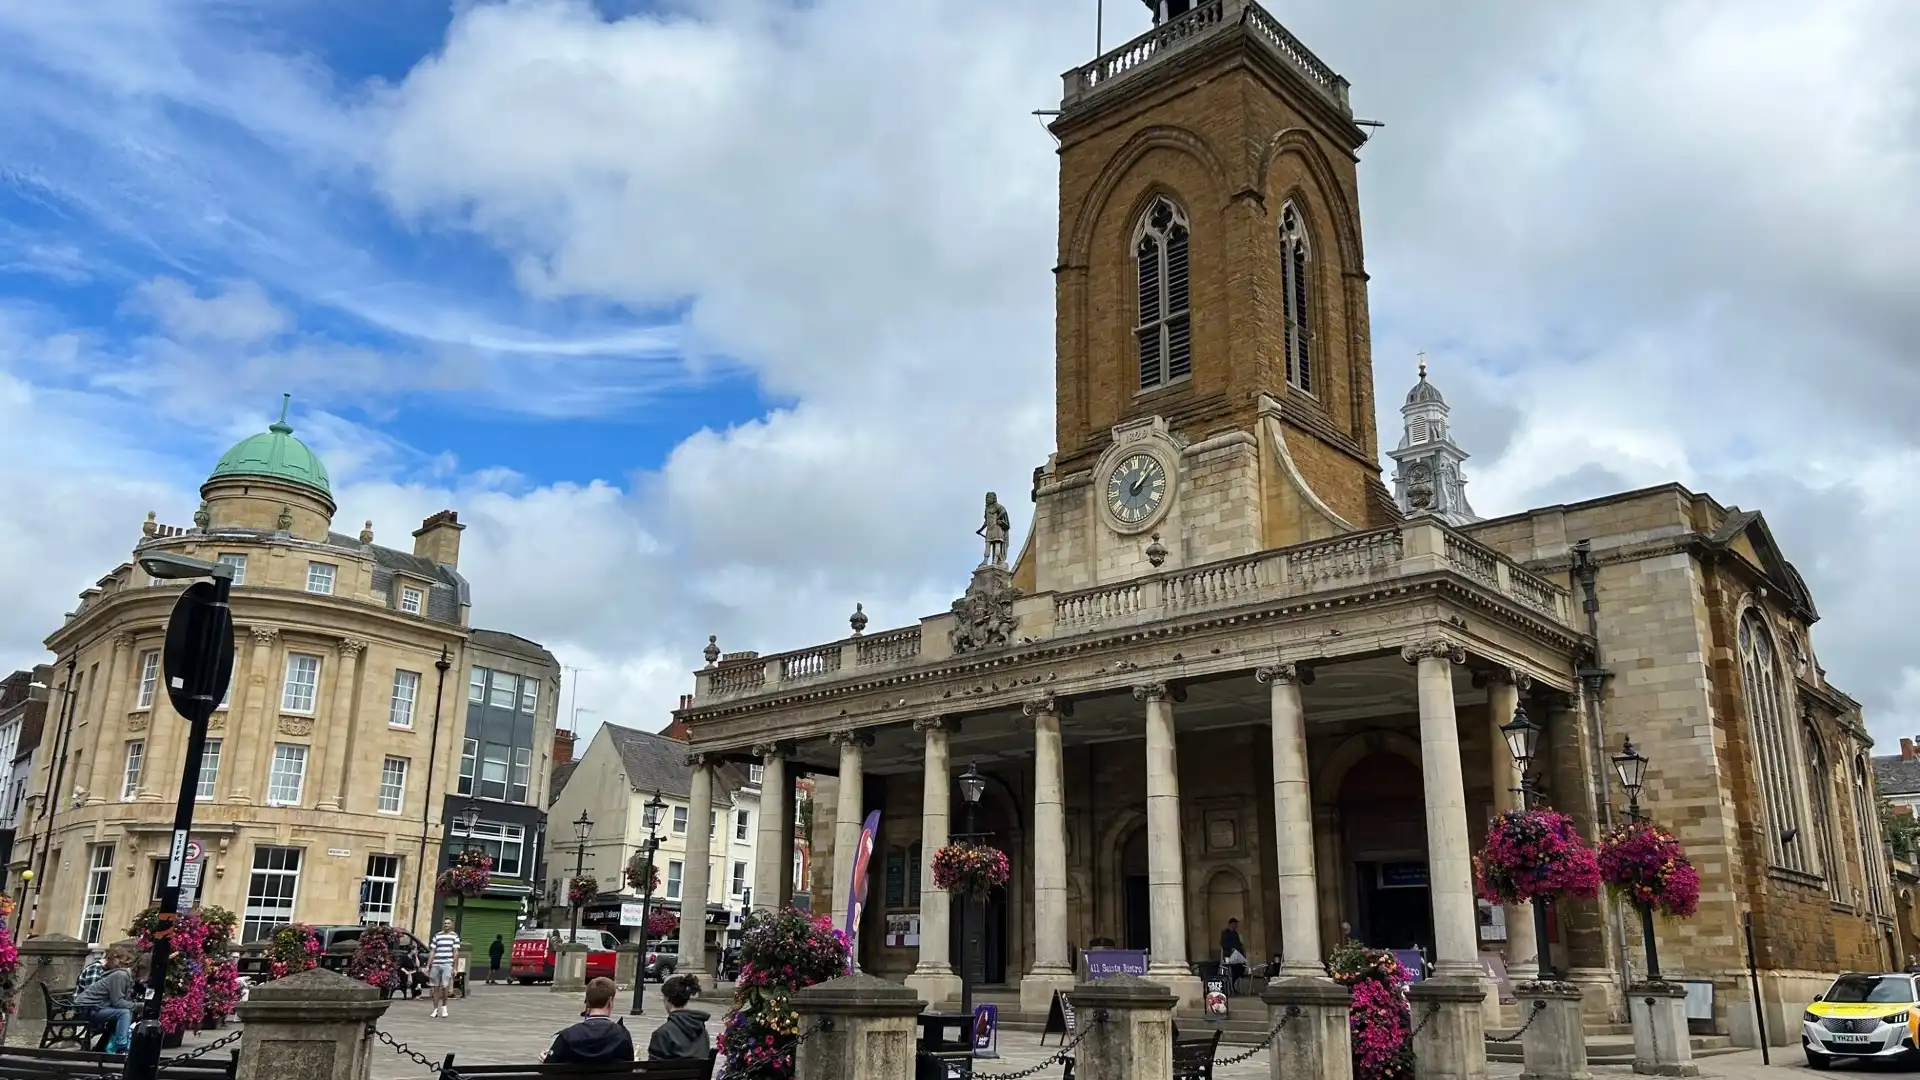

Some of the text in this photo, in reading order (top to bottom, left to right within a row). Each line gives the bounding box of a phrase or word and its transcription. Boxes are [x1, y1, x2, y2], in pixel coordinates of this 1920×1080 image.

[1090, 963, 1143, 974] All Saints Bistro
